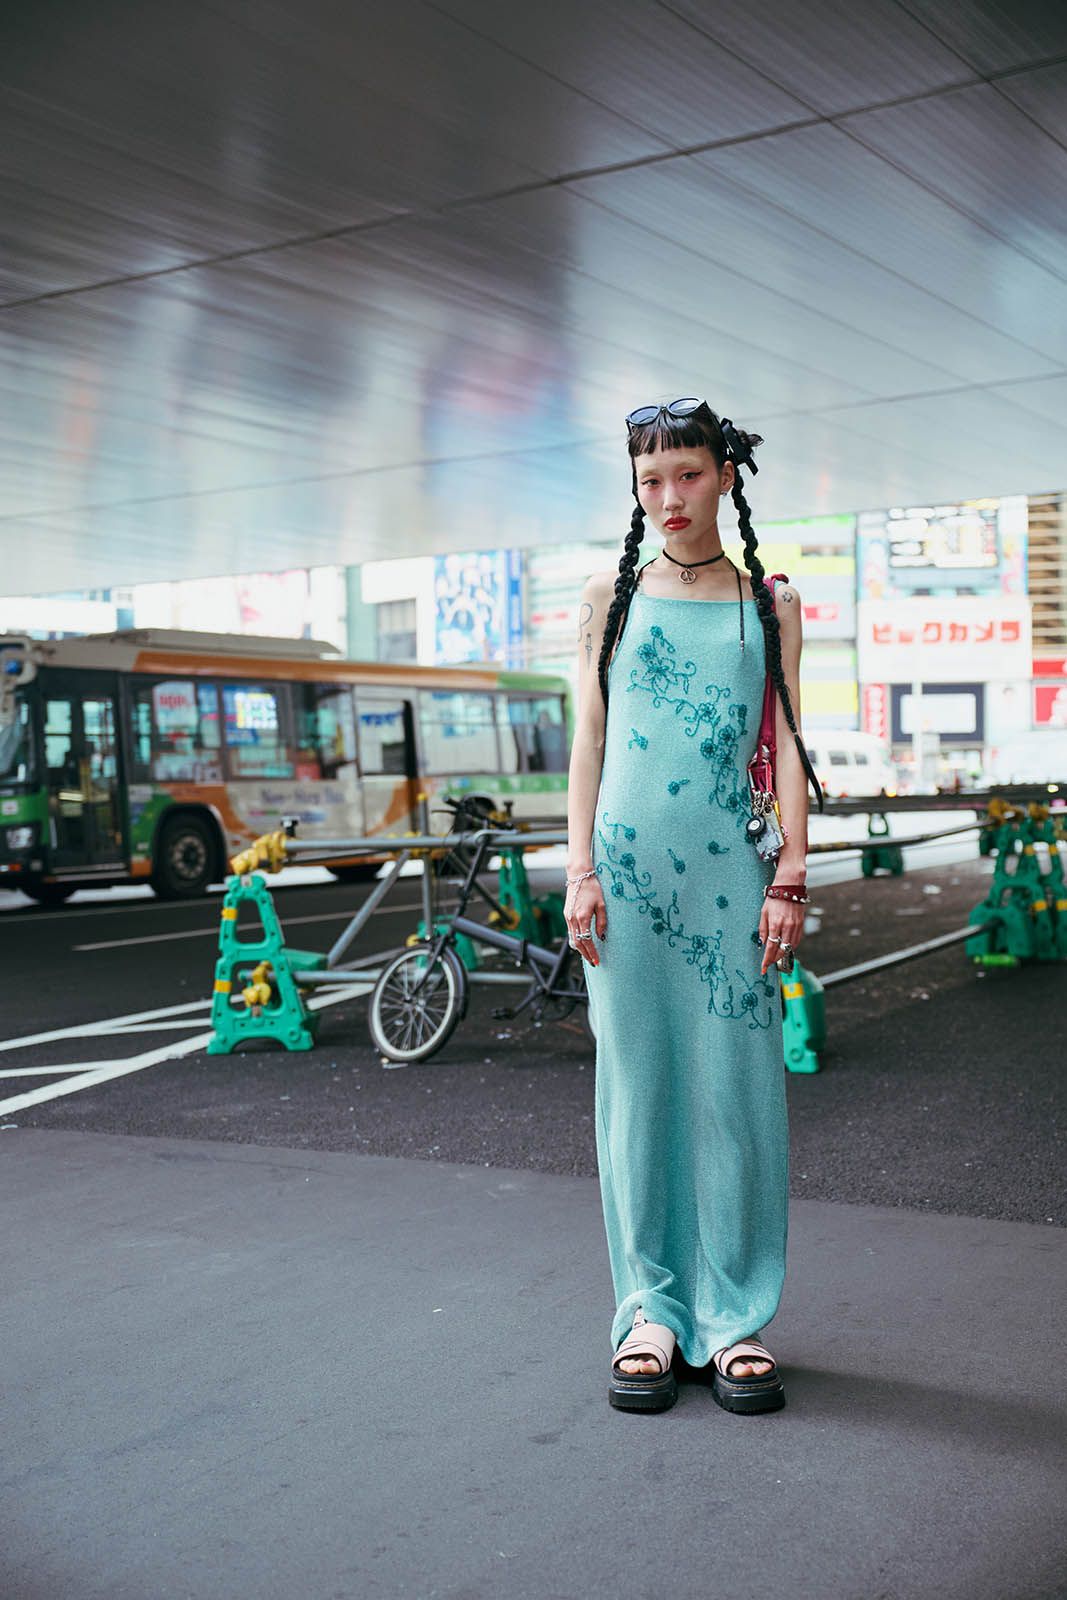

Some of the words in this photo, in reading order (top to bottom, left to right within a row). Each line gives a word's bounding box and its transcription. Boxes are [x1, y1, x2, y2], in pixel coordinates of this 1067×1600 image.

[873, 621, 1020, 642] ビックカメラ
